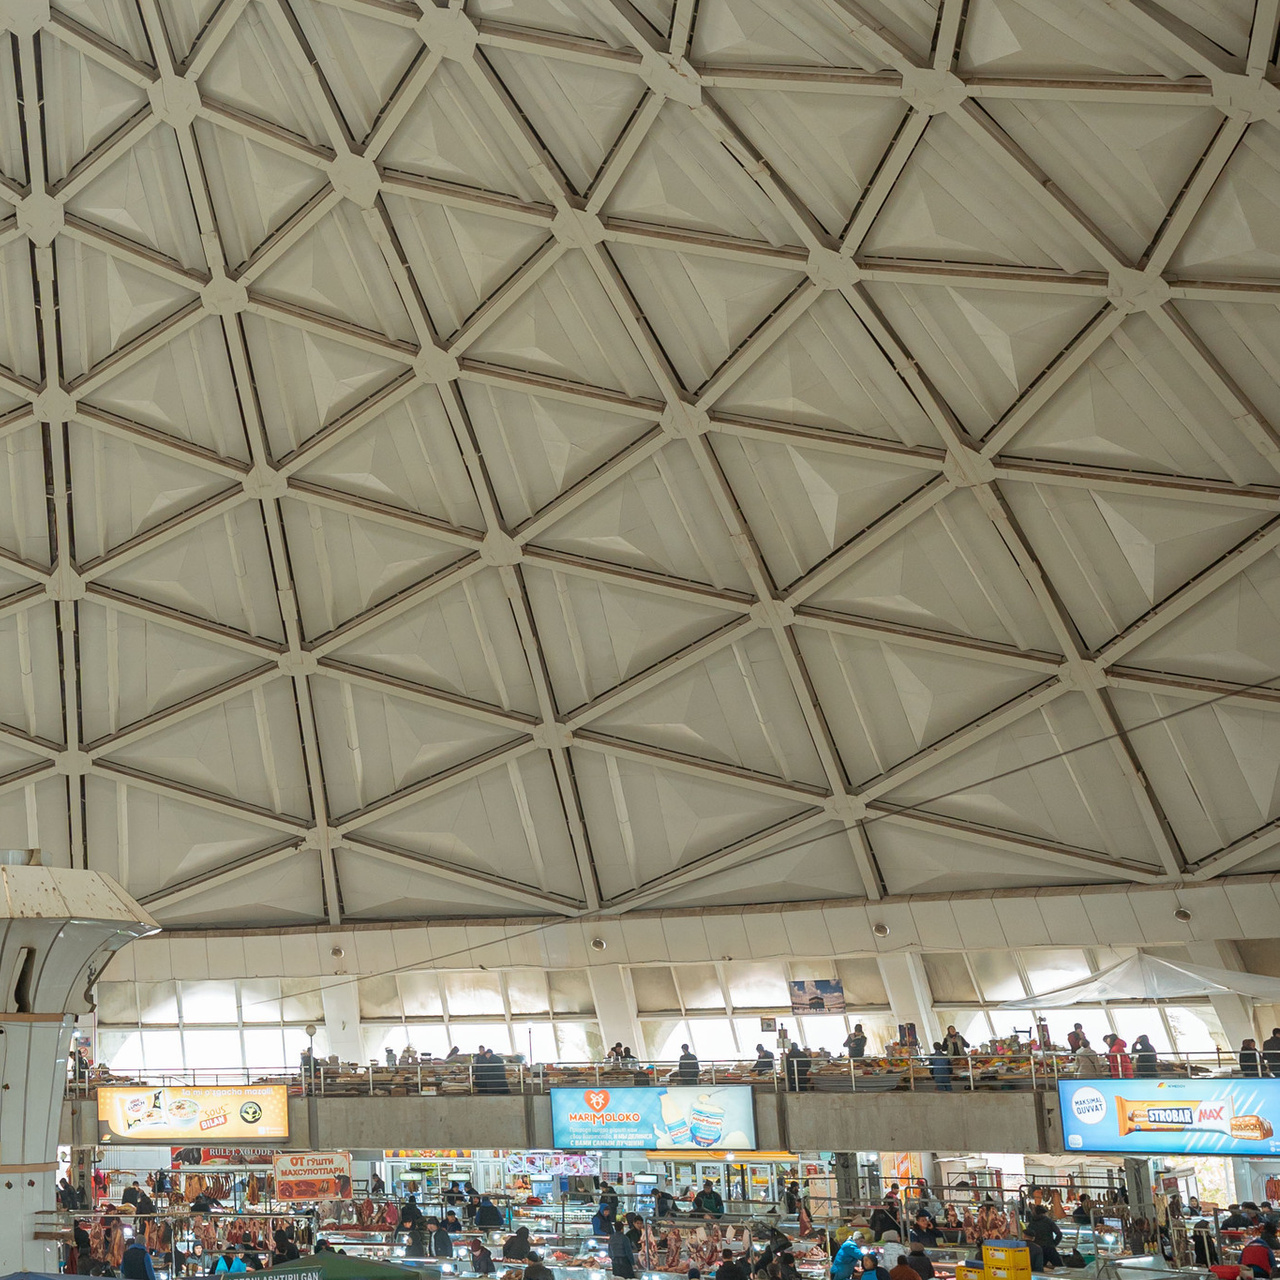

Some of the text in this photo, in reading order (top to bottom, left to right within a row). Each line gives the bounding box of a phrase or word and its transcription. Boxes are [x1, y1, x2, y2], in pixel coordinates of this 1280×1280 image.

[1074, 1097, 1102, 1106] MAKSIMAL
[1076, 1103, 1103, 1115] QUVVAT
[1198, 1106, 1225, 1122] MAX
[202, 1116, 226, 1129] BILAN
[1149, 1109, 1192, 1124] STROBAR
